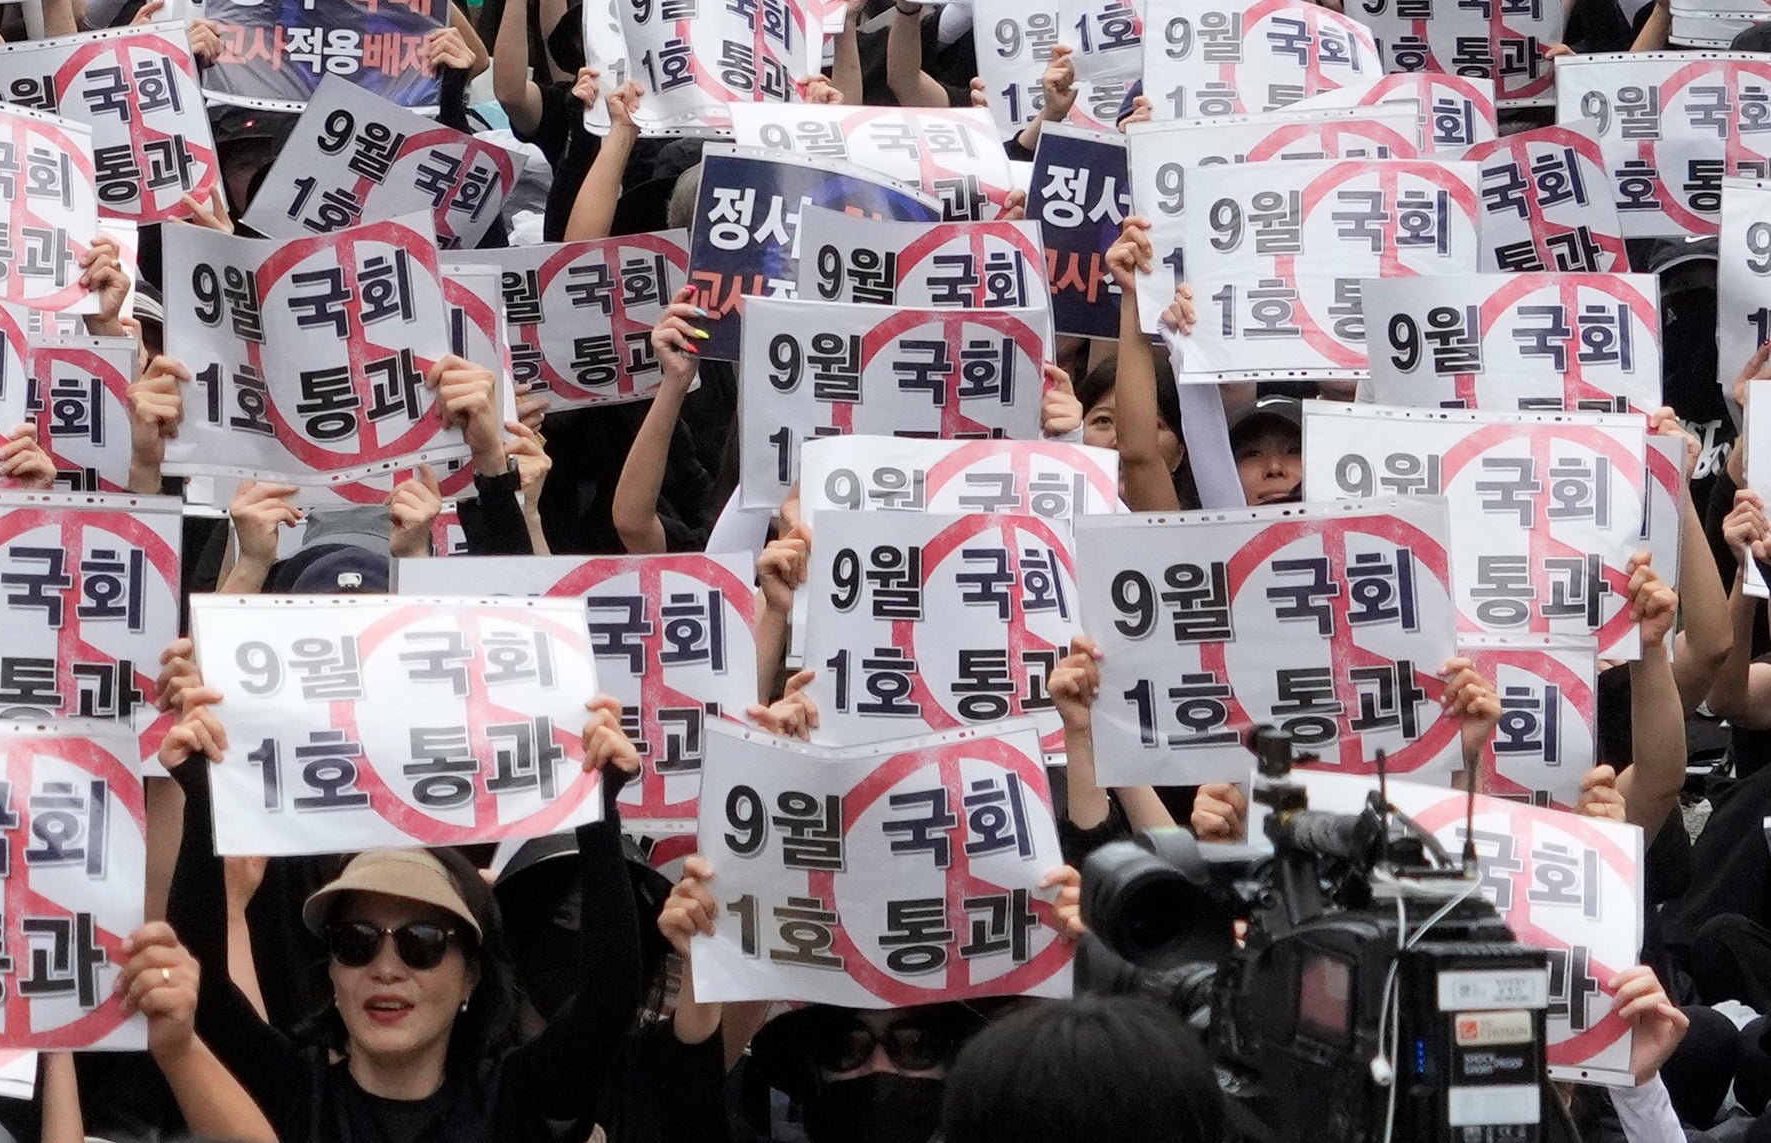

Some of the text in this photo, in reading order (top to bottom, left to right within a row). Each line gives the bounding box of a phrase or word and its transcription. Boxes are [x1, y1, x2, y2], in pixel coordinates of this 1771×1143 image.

[641, 39, 792, 104] 1호 통과
[1074, 1, 1142, 55] 1호
[316, 108, 502, 224] 9월 국회
[1041, 163, 1132, 230] 정서
[707, 186, 801, 260] 정서
[1209, 188, 1453, 258] 9월 국회
[191, 247, 417, 344] 9월 국회
[195, 348, 430, 442] 1호 통과
[0, 544, 146, 632] 국회
[1110, 547, 1420, 645] 9월 국회
[1469, 552, 1612, 635] 통과
[234, 630, 560, 702] 9월 국회
[246, 715, 565, 814] 1호 통과
[724, 771, 1035, 873] 9월 국회
[726, 887, 1038, 976] 1호 통과
